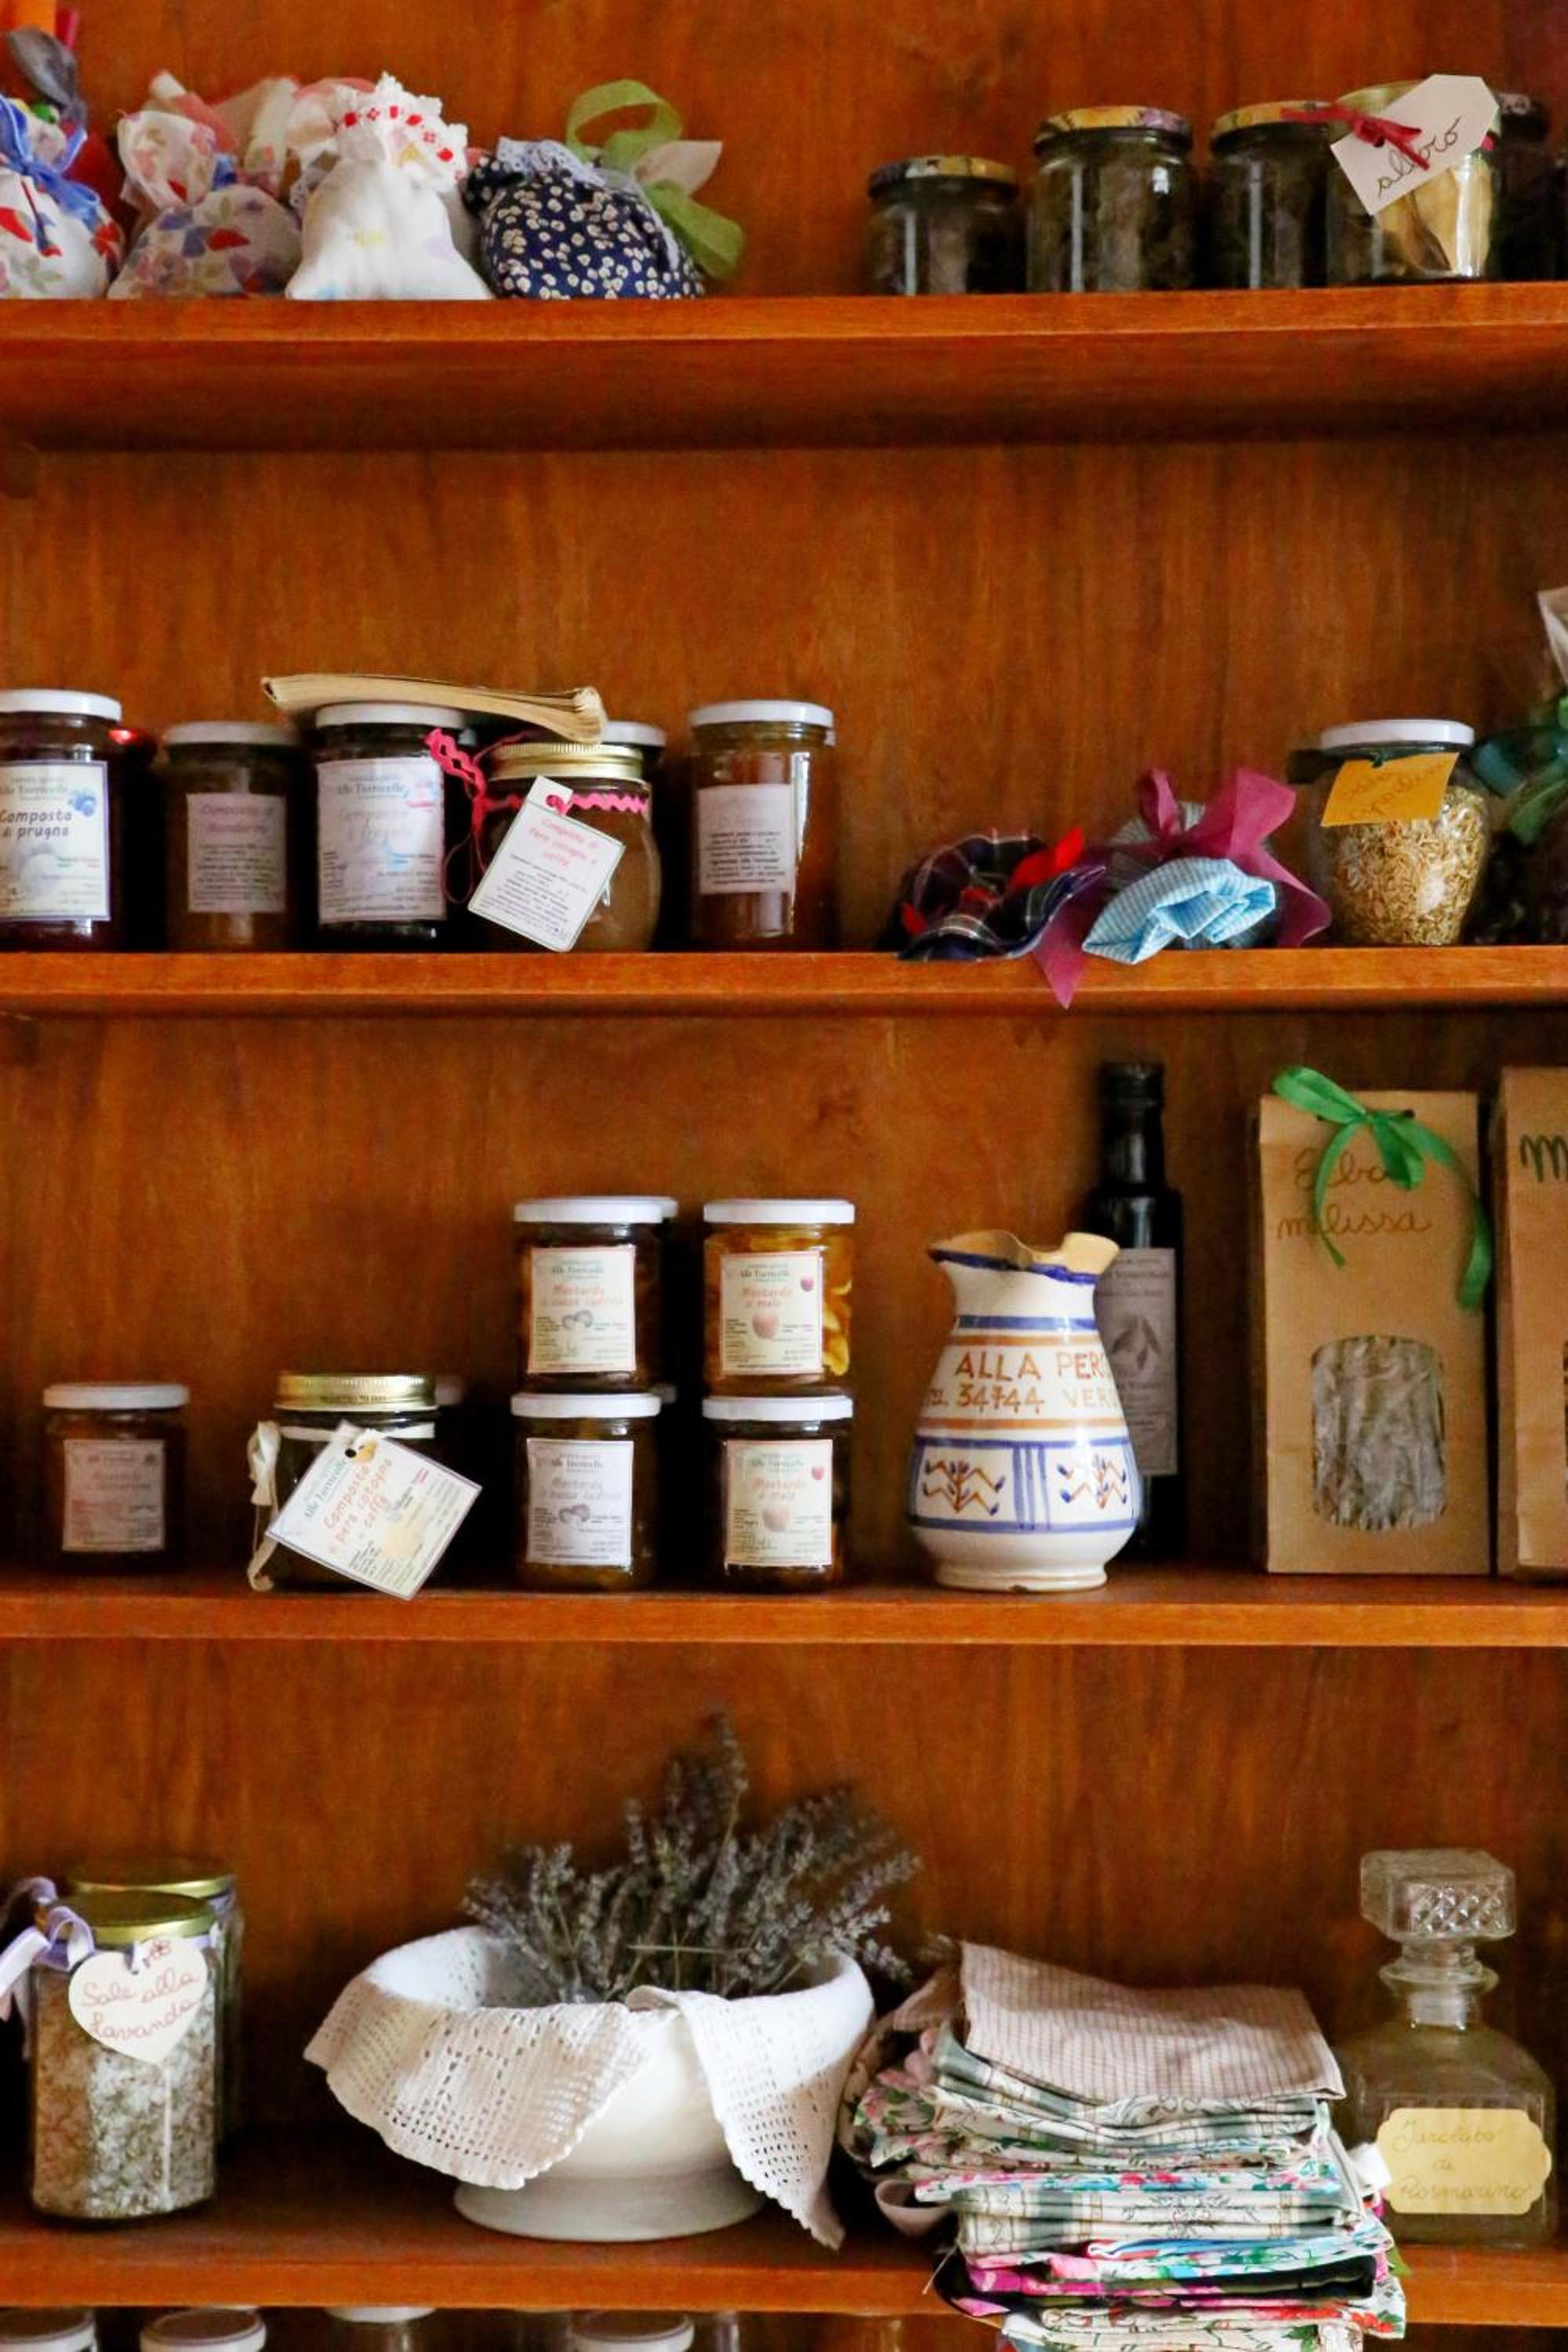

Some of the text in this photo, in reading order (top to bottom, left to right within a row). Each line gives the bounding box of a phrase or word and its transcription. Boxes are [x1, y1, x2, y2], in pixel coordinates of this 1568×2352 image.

[0, 809, 73, 824] Composta
[1276, 1203, 1432, 1240] mlissa
[953, 1351, 1042, 1381] ALLA
